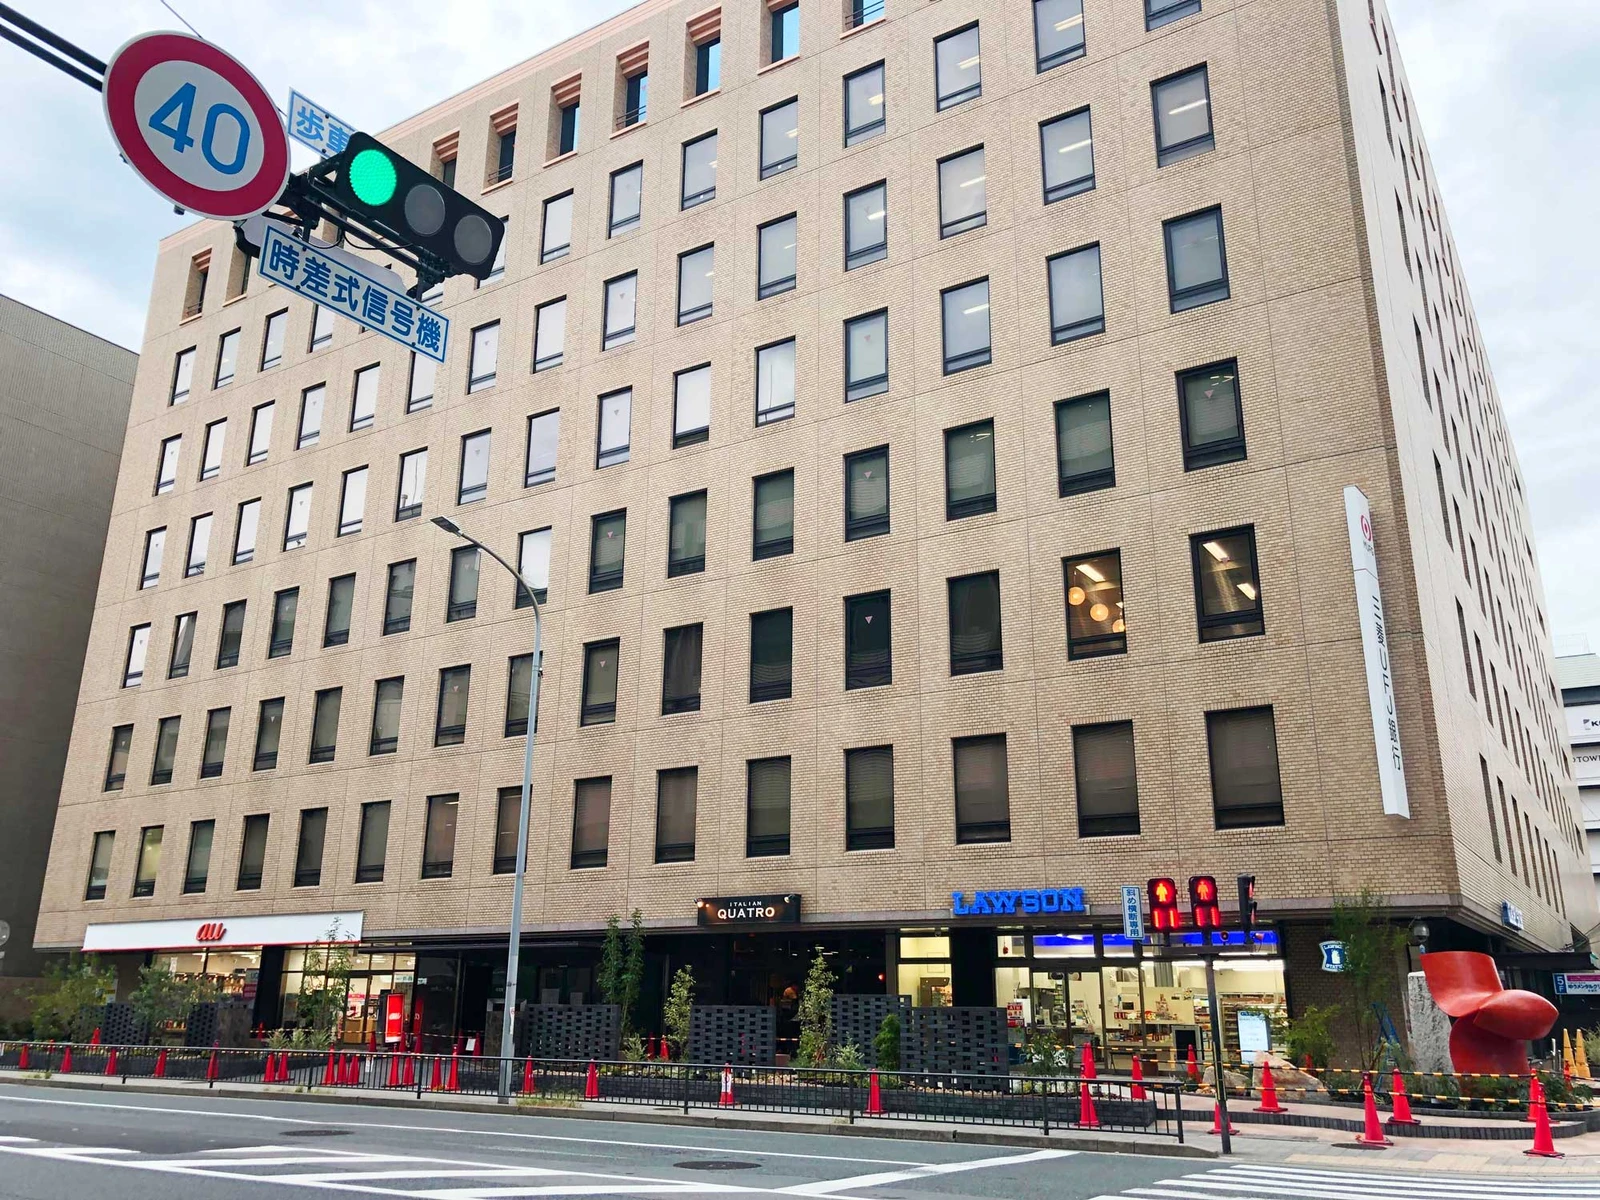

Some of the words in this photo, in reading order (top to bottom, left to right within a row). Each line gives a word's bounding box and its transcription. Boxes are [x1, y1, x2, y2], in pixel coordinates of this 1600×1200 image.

[148, 82, 250, 175] 40
[269, 239, 441, 352] 時差式信号機
[717, 907, 775, 919] QUATRO
[952, 887, 1085, 915] LAWSON
[1126, 888, 1140, 937] 斜め横断専用
[196, 923, 227, 941] au
